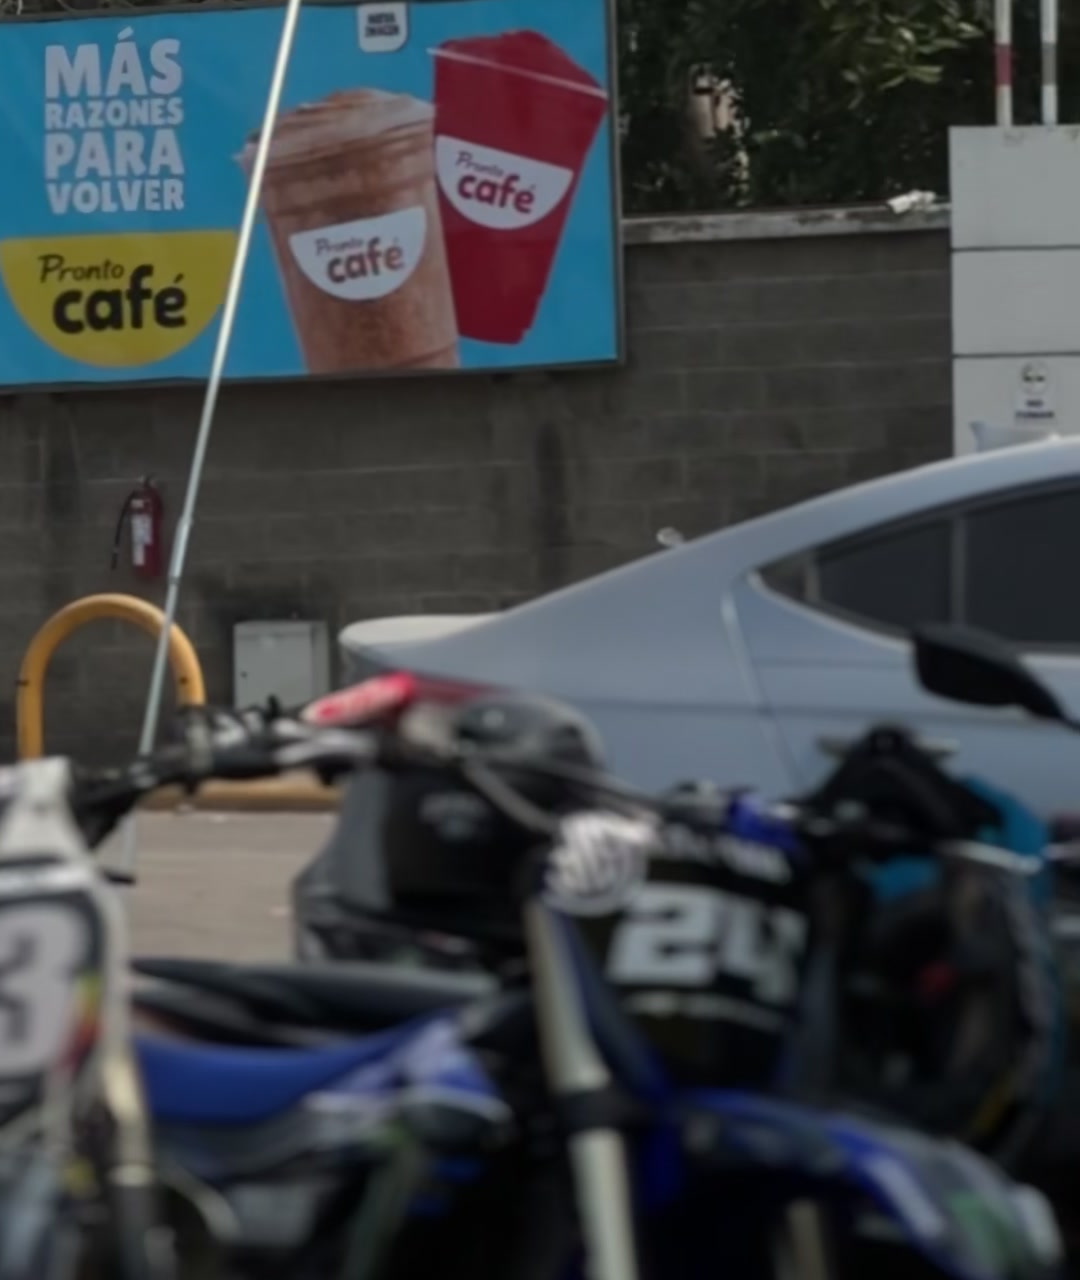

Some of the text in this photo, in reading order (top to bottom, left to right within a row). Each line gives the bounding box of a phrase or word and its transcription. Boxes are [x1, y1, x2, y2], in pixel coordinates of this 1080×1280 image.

[45, 27, 183, 98] MÁS
[44, 97, 184, 130] RAZONES
[44, 129, 185, 179] PARA
[46, 179, 185, 215] VOLVER
[457, 173, 536, 214] café
[38, 254, 124, 283] Pronto
[327, 236, 405, 283] café
[52, 264, 187, 334] café
